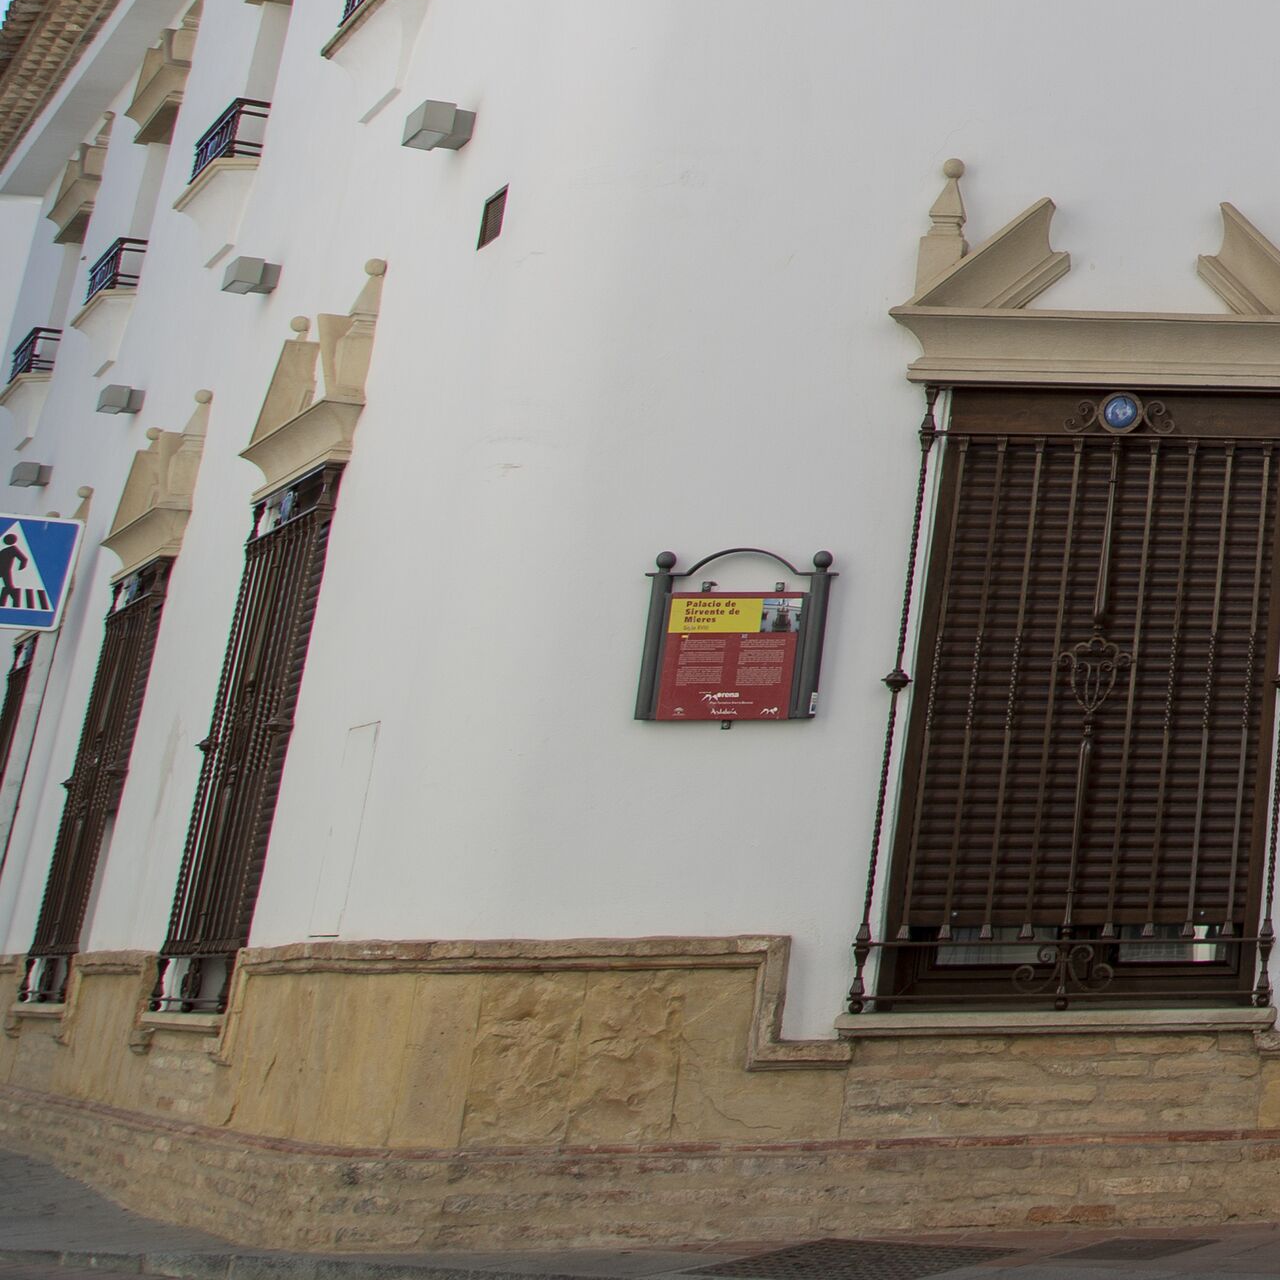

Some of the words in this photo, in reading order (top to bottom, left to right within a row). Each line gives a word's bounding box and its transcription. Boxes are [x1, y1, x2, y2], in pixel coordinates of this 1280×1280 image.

[686, 600, 721, 608] Palacio
[725, 600, 737, 608] de
[685, 608, 725, 616] Sirvente
[729, 608, 740, 616] de
